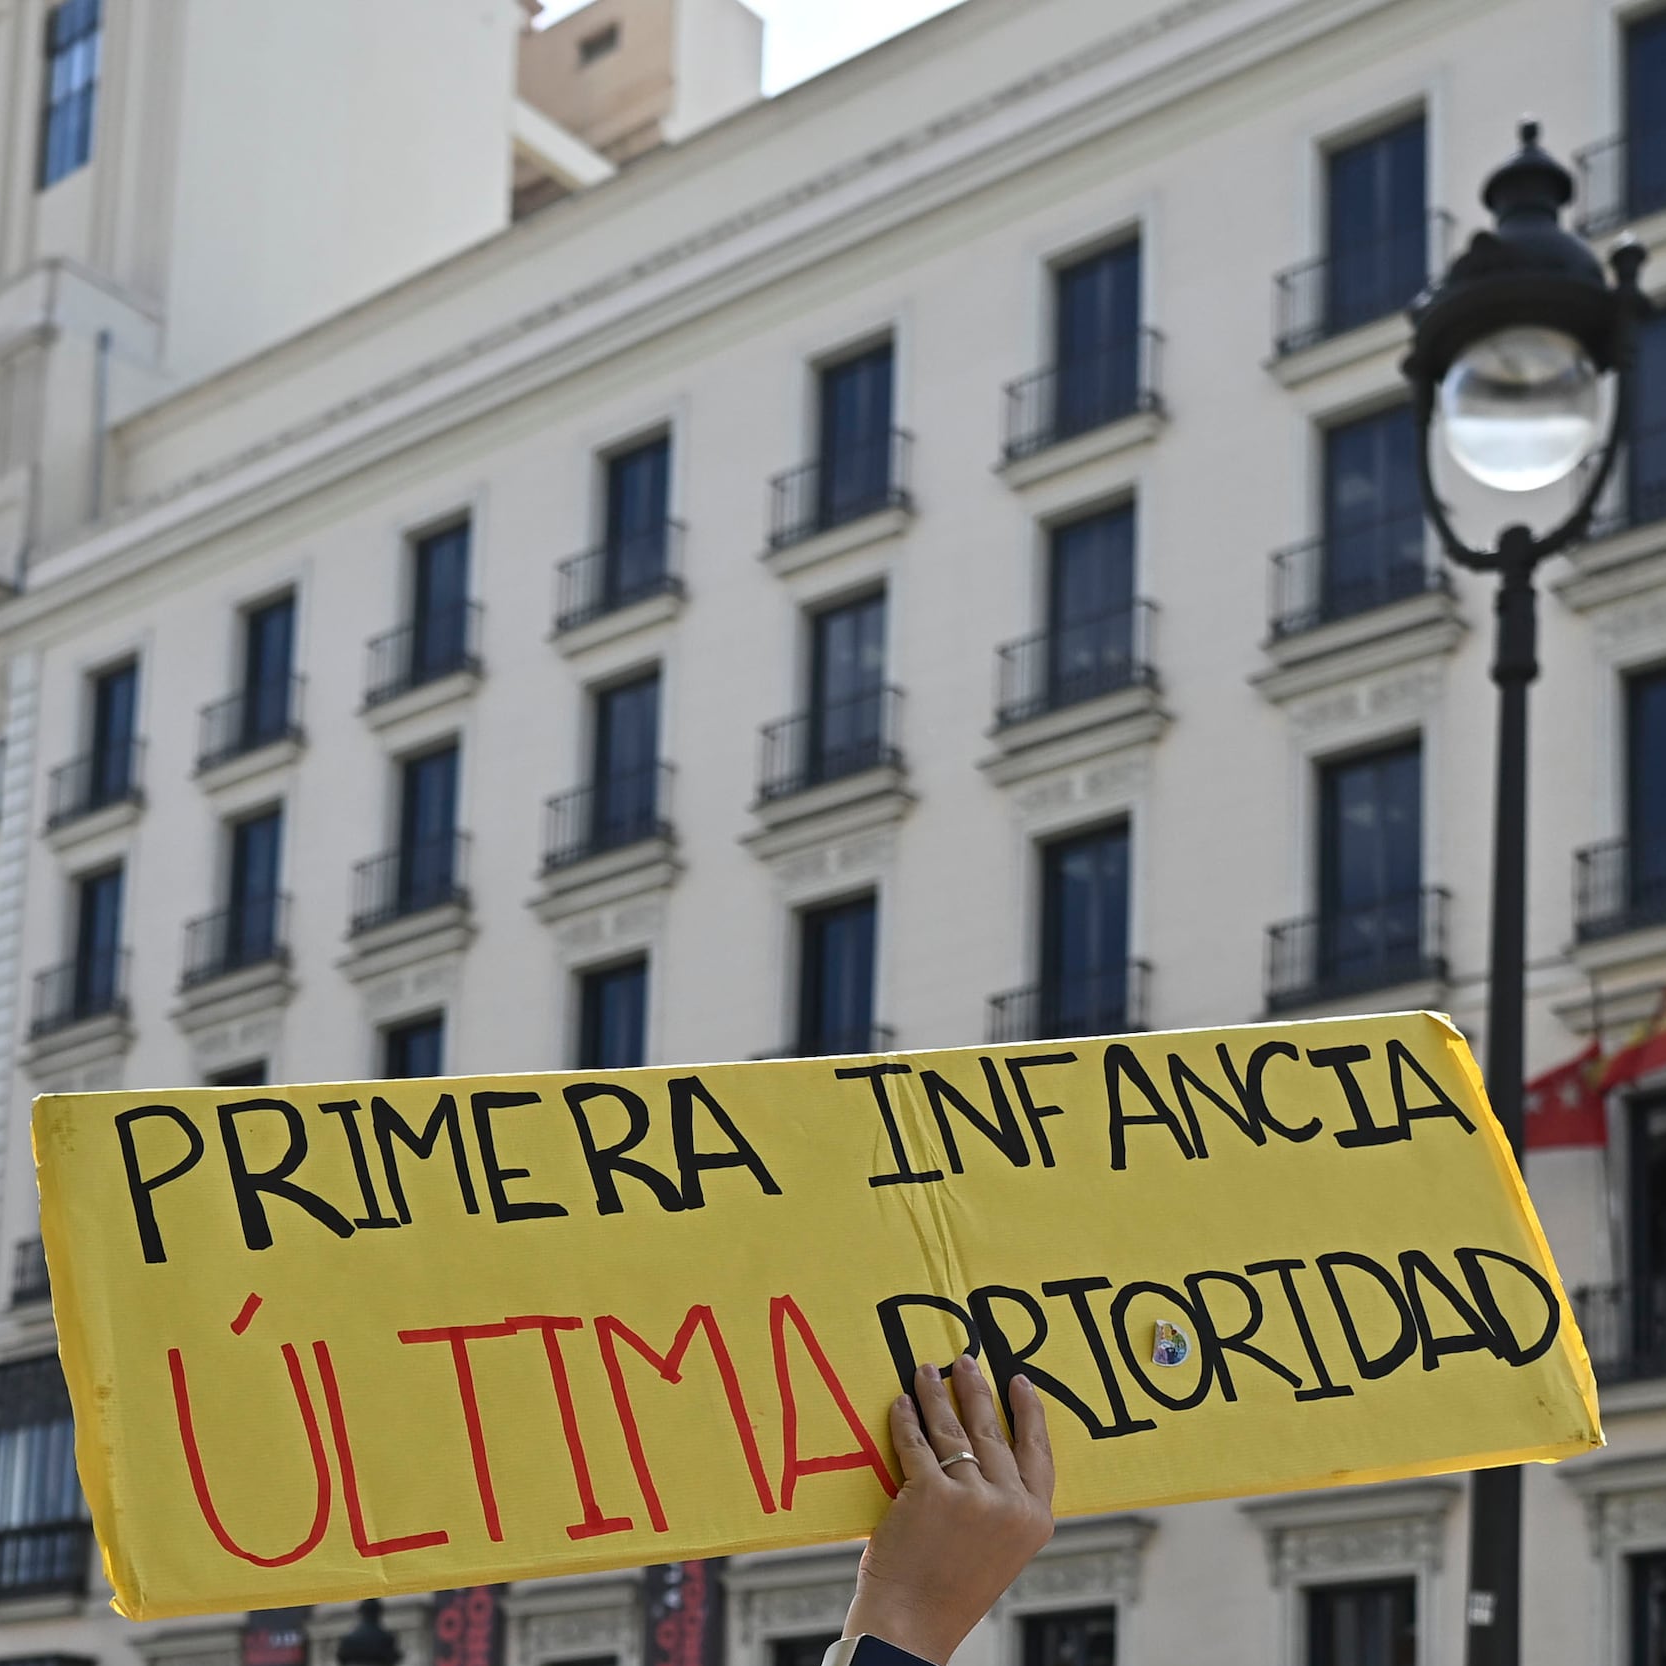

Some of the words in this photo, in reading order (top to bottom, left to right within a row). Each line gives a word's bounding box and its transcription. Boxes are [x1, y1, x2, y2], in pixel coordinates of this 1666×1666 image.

[114, 1075, 783, 1264] PRIMERA
[833, 1040, 1477, 1188] INFANCIA
[169, 1293, 901, 1568] ÚLTIMA
[875, 1247, 1561, 1440] PRIORIDAD
